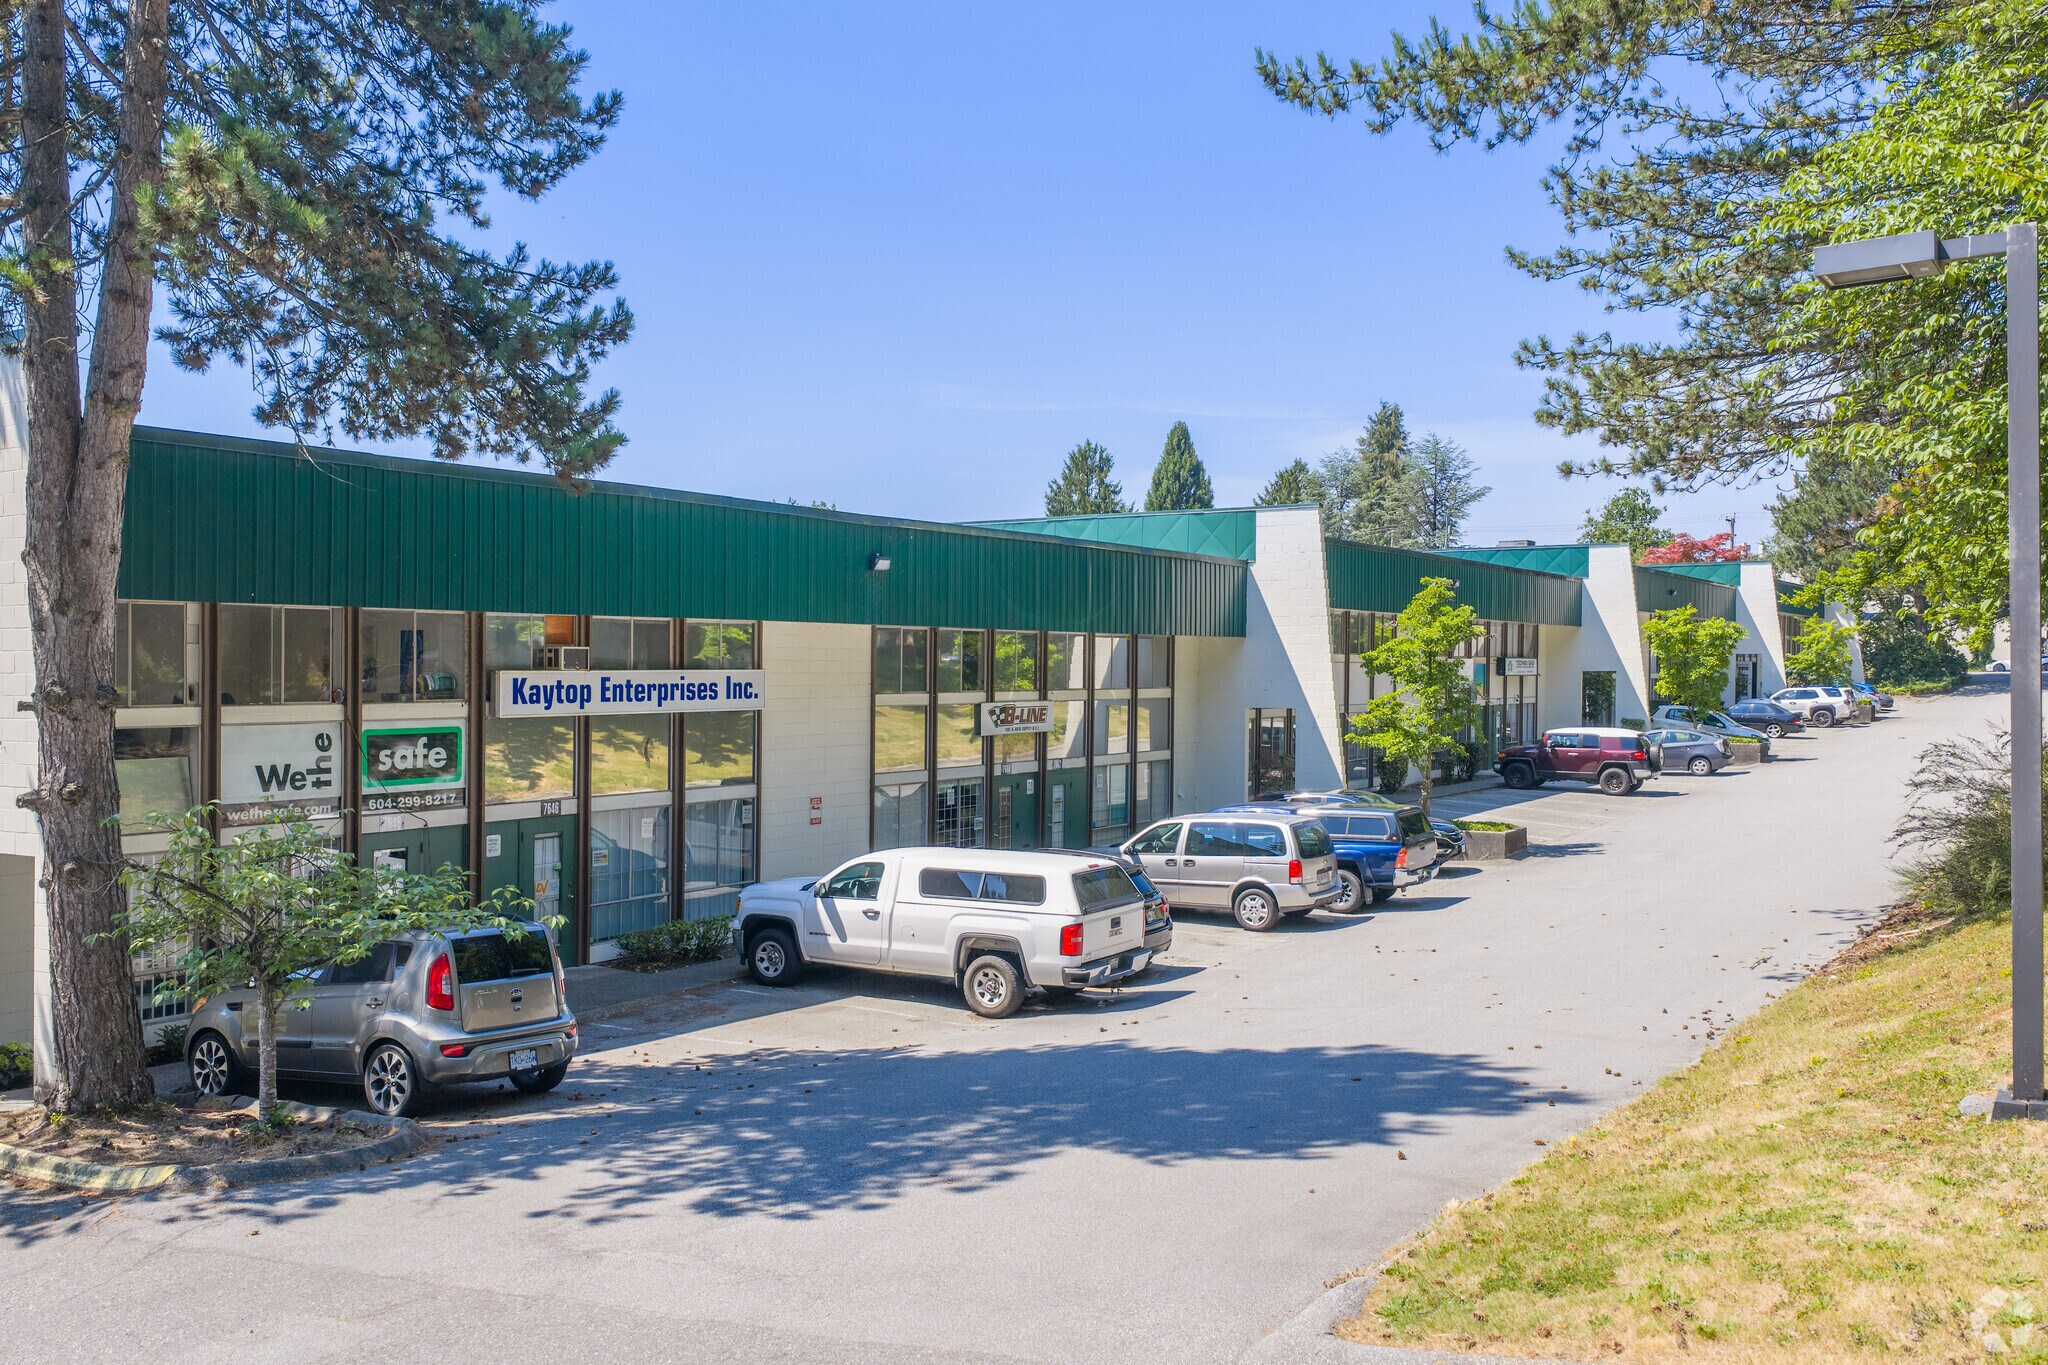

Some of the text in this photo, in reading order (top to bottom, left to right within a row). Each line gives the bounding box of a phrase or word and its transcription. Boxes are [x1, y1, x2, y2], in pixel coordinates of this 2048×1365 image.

[512, 675, 759, 711] Kaytop Enterprises Inc.
[1000, 704, 1047, 725] B-LINE
[306, 732, 333, 790] the
[378, 736, 448, 771] safe
[255, 763, 307, 792] We
[368, 793, 456, 810] 604-299-8217
[543, 802, 559, 815] 7646
[382, 815, 402, 830] 7648
